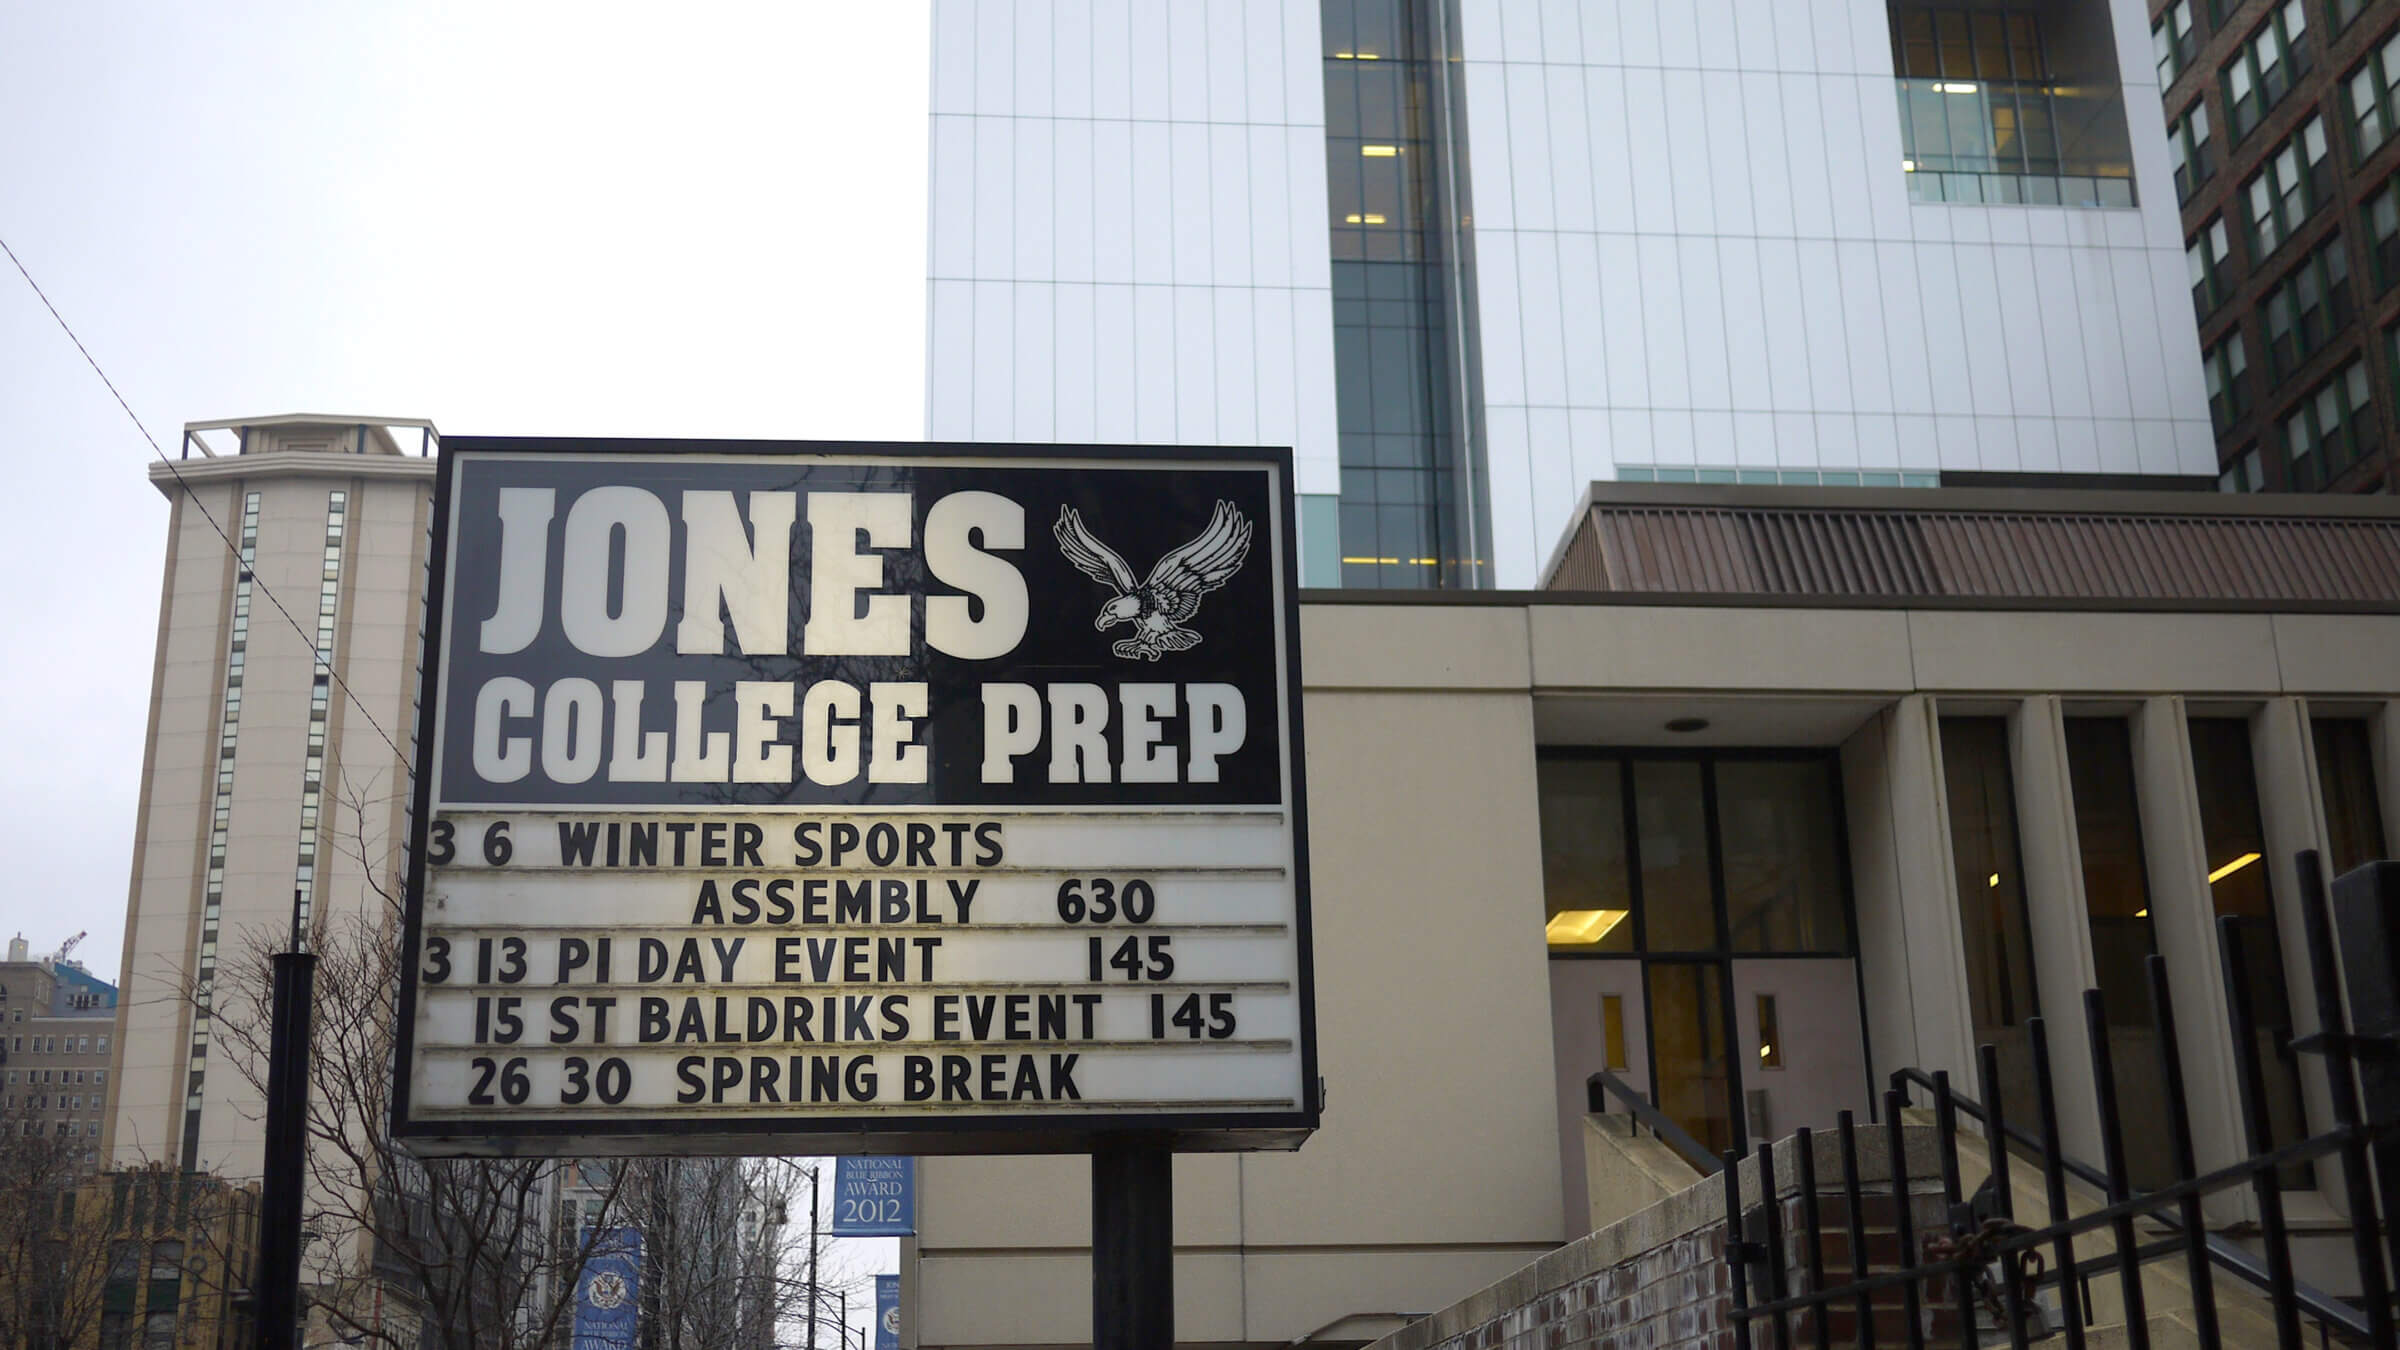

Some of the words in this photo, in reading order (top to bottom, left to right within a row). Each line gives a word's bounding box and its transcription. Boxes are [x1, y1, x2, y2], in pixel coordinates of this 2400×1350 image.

[479, 486, 1030, 660] JONES
[472, 677, 929, 786] COLLEGE
[981, 682, 1247, 785] PREP
[426, 820, 456, 867] 3
[483, 820, 513, 867] 6
[558, 821, 765, 867] WINTER
[794, 821, 1004, 867] SPORTS
[692, 878, 981, 925] ASSEMBLY
[1056, 878, 1155, 924] 630
[422, 937, 452, 984] 3
[477, 937, 527, 984] 13
[558, 937, 611, 984] PI
[638, 937, 746, 983] DAY
[775, 937, 942, 983] EVENT
[1089, 935, 1175, 982] 145
[474, 995, 524, 1044] 15
[549, 996, 617, 1044] ST
[638, 995, 911, 1043] BALDRIKS
[933, 993, 1102, 1040] EVENT
[1151, 993, 1237, 1040] 145
[468, 1056, 531, 1106] 26
[560, 1056, 632, 1106] 30
[676, 1055, 878, 1104] SPRING
[903, 1053, 1082, 1102] BREAK
[846, 1159, 904, 1169] NATIONAL
[842, 1199, 903, 1223] 2012
[844, 1181, 904, 1196] AWARD
